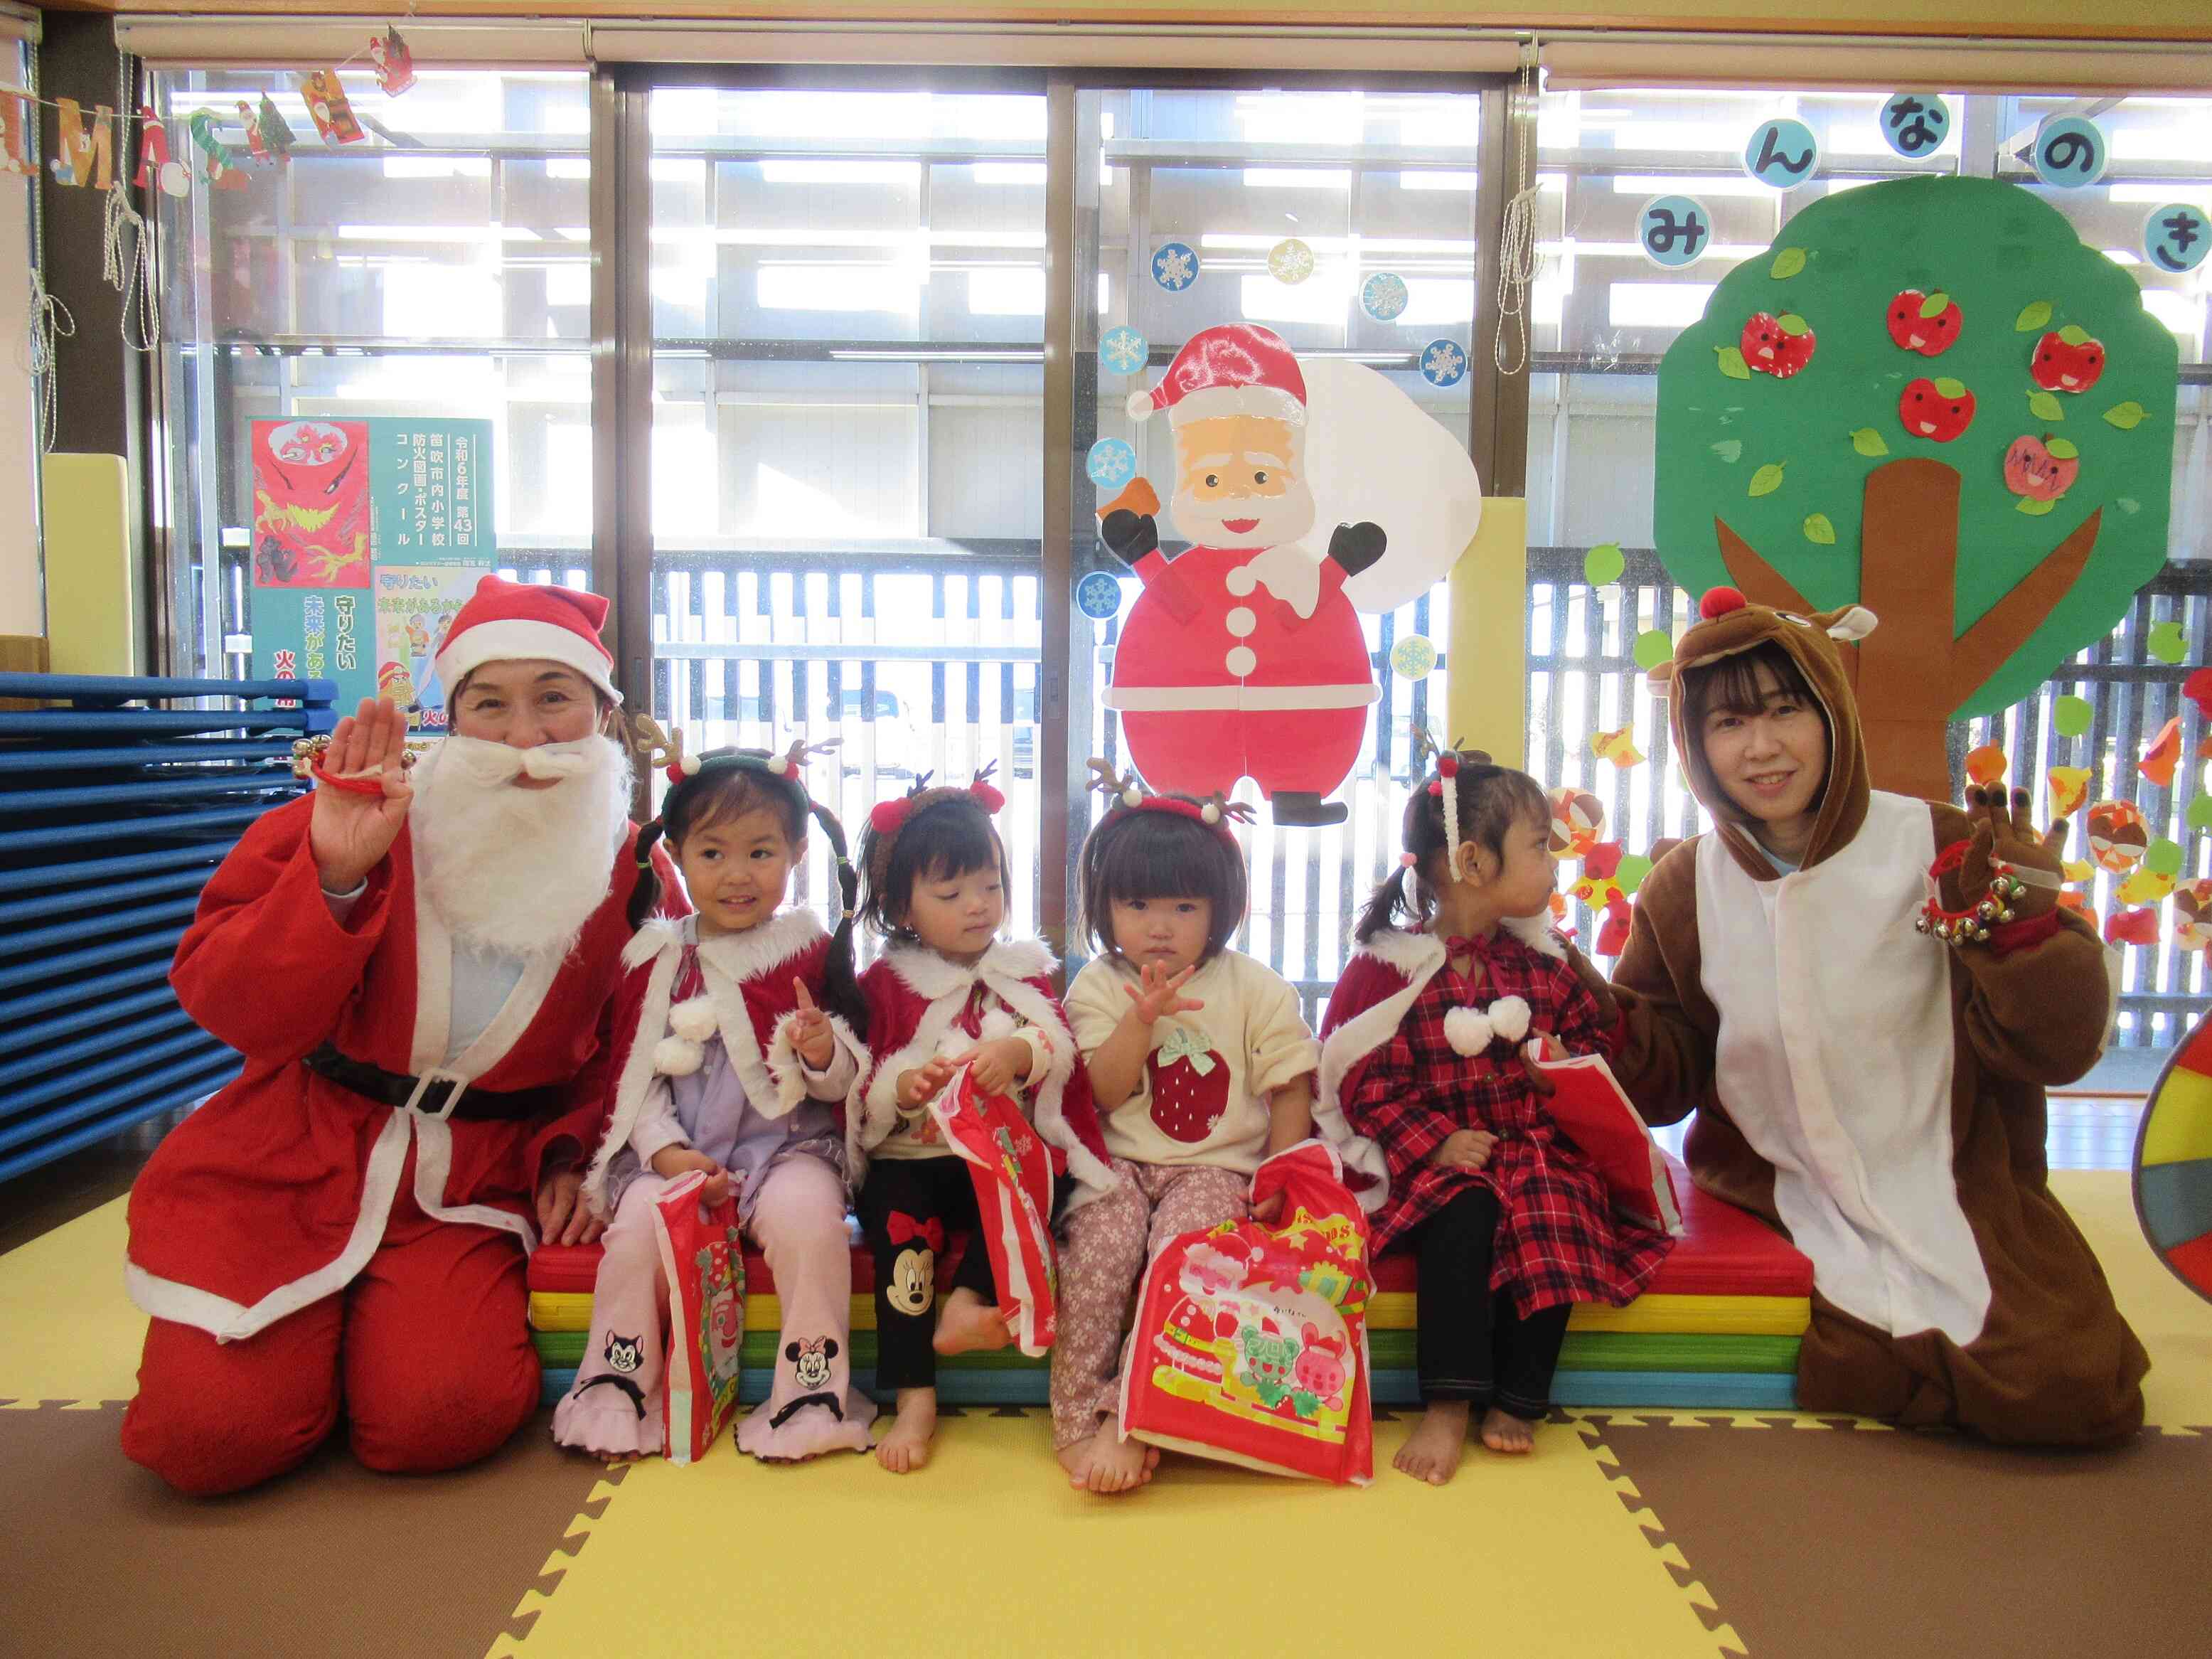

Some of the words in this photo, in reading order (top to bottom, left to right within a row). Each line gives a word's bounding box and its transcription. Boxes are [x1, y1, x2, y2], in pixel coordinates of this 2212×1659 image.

[396, 433, 411, 545] コンクール
[412, 432, 428, 546] 防火図画・ポスター
[429, 433, 446, 546] 笛吹市内小学校
[455, 436, 470, 501] 令和6年度
[453, 506, 473, 545] 第43回
[380, 574, 438, 590] 守りたい
[334, 595, 356, 671] 守りたい
